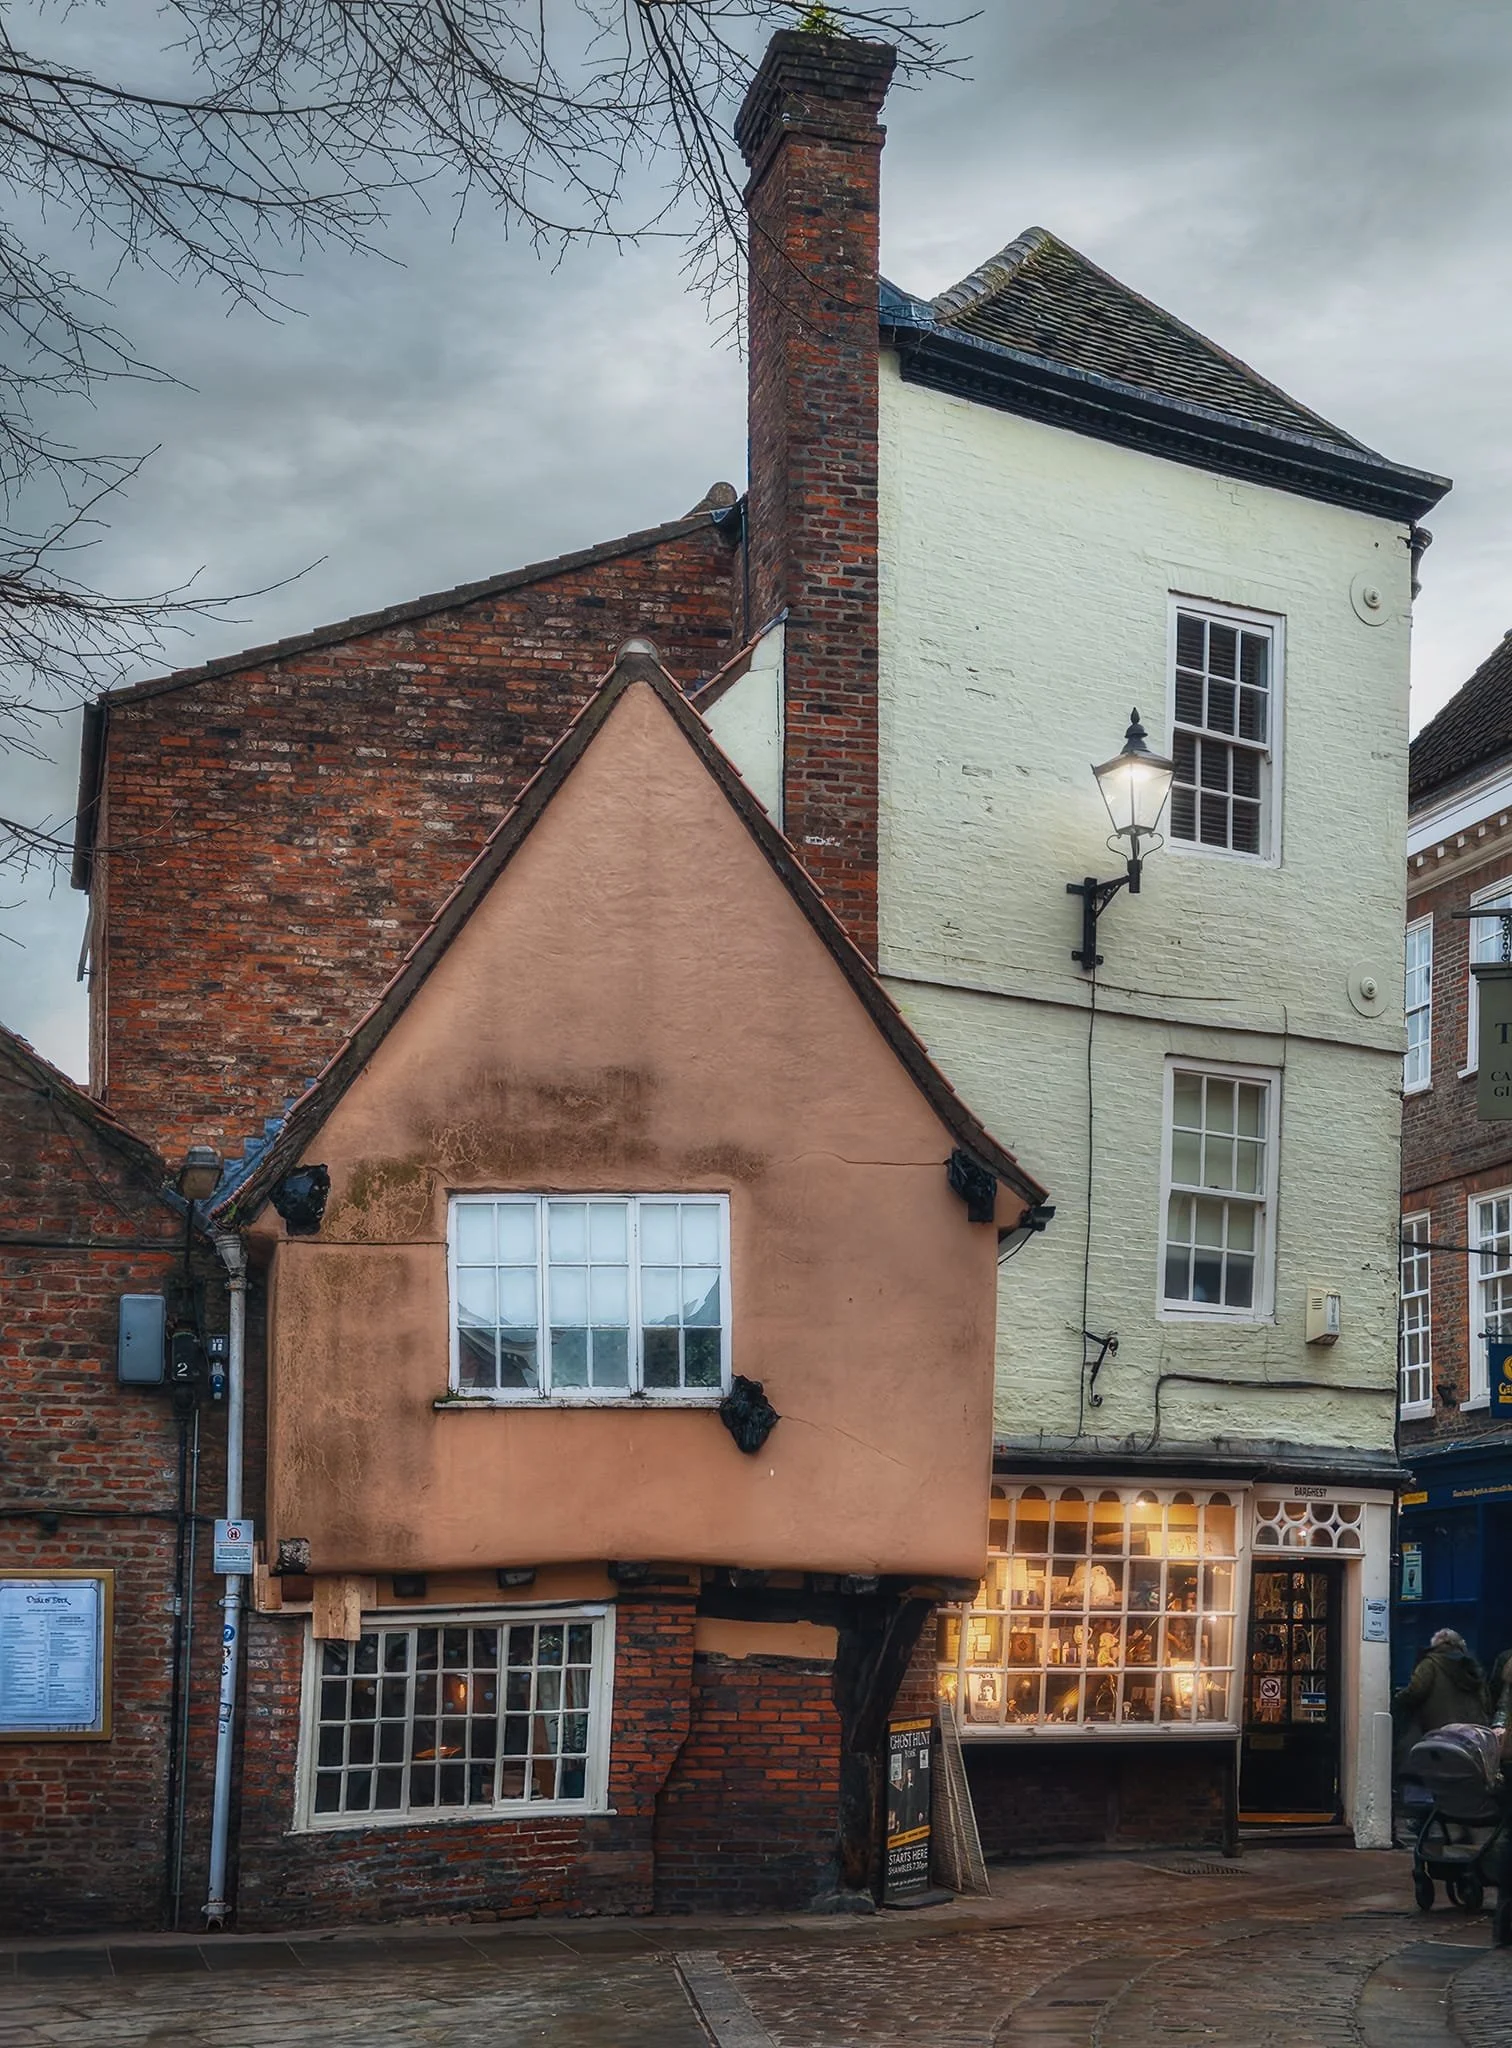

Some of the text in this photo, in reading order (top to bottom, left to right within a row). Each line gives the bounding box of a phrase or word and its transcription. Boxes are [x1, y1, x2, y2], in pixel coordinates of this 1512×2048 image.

[176, 1362, 188, 1377] 2
[888, 1850, 911, 1866] STARTS
[912, 1847, 928, 1861] HERE
